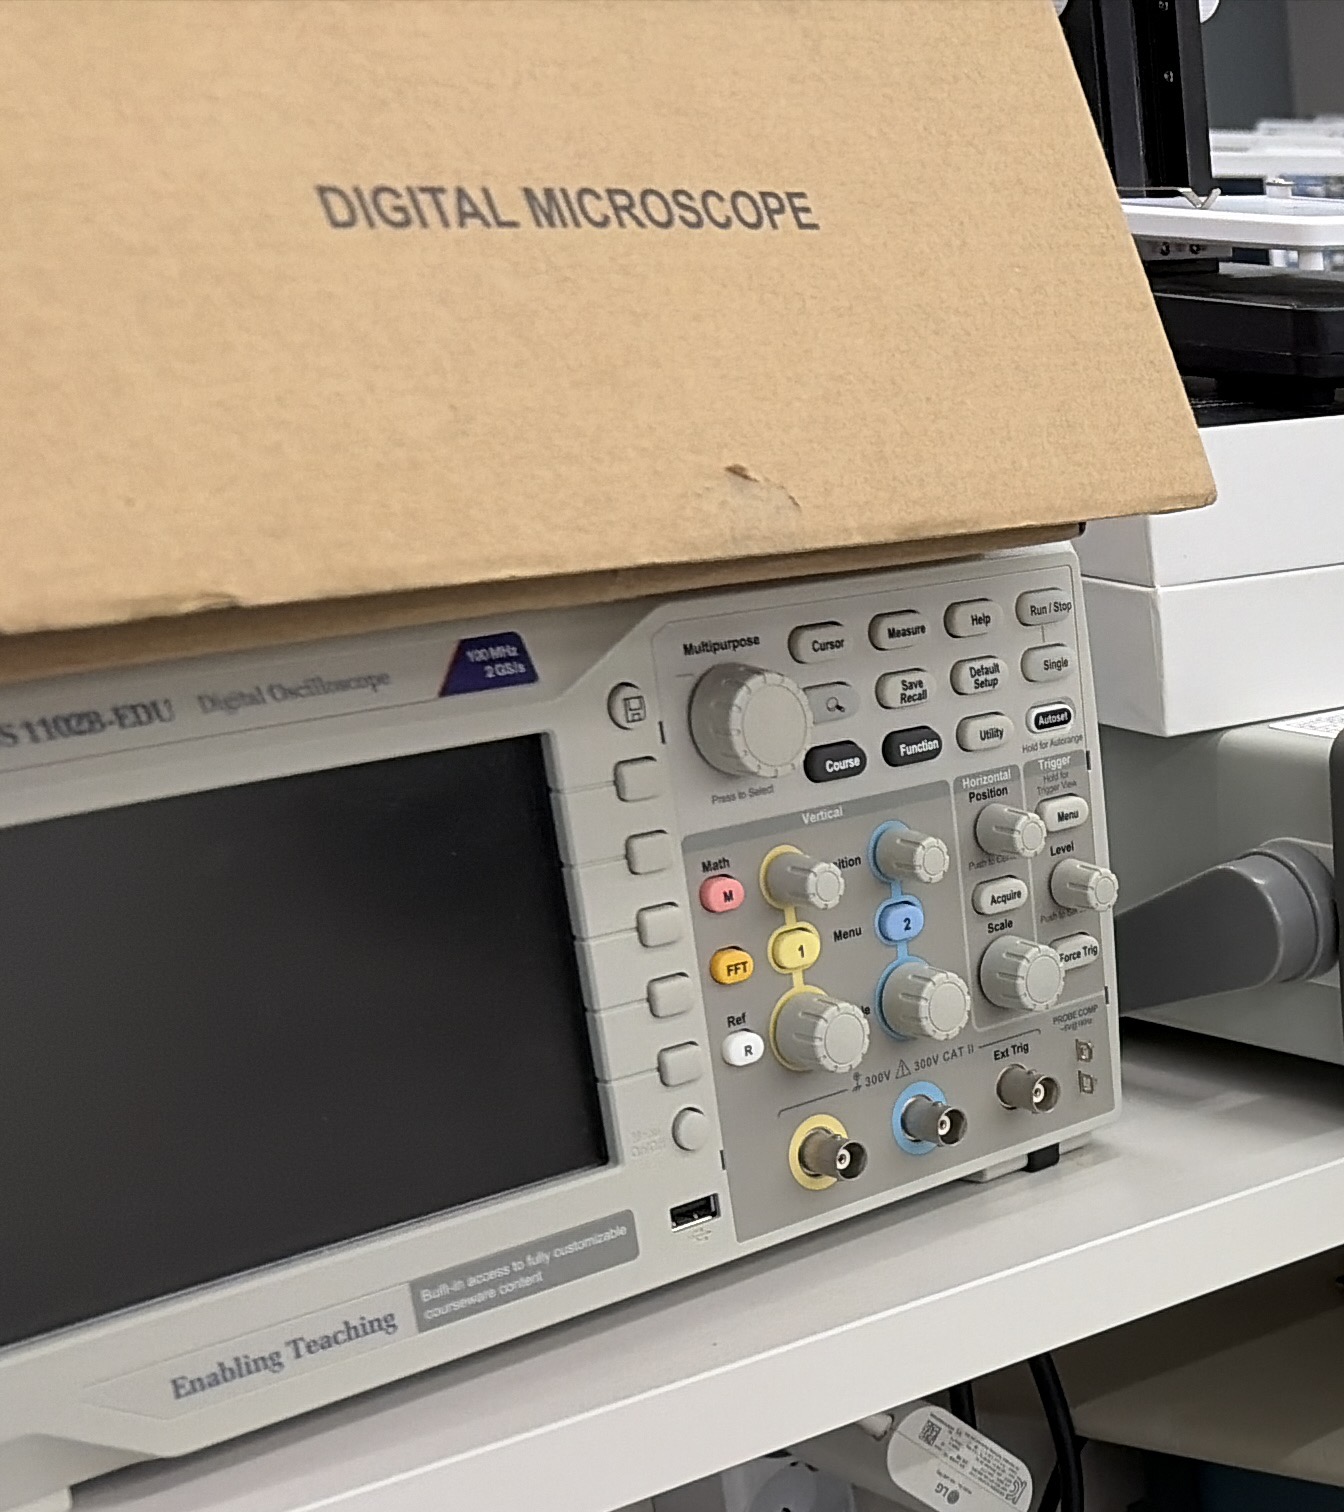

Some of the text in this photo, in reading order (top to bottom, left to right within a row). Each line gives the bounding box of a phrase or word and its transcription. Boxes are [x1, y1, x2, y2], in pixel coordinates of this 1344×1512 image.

[316, 184, 820, 231] DIGITAL MICROSCOPE
[1030, 601, 1072, 616] Run Stop
[971, 614, 991, 627] Help
[888, 624, 926, 639] Measure
[683, 635, 760, 656] Multipurpose
[812, 639, 844, 652] Cursor
[969, 663, 1000, 678] Default
[1044, 657, 1068, 671] Single
[901, 680, 924, 691] Save
[974, 676, 998, 690] Setup
[900, 690, 927, 704] Recall
[1038, 711, 1068, 725] Autoset
[980, 728, 1004, 741] Utility
[900, 739, 940, 757] Function
[825, 756, 861, 772] Course
[1038, 755, 1071, 771] Trigger
[962, 770, 1011, 789] Horizontal
[969, 786, 1008, 803] Position
[802, 806, 844, 825] Vertical
[1057, 811, 1079, 823] Menu
[1050, 842, 1074, 857] Level
[702, 857, 730, 873] Math
[723, 890, 733, 902] M
[990, 888, 1022, 907] Acquire
[903, 918, 912, 931] 2
[987, 918, 1013, 934] Scale
[833, 926, 862, 943] Menu
[797, 945, 805, 959] 1
[1059, 944, 1098, 963] Force Trig
[726, 961, 748, 977] FFT
[727, 1012, 747, 1028] Ref
[993, 1042, 1029, 1062] Ext Trig
[499, 1271, 543, 1297] content
[170, 1310, 399, 1401] Enabling Teaching
